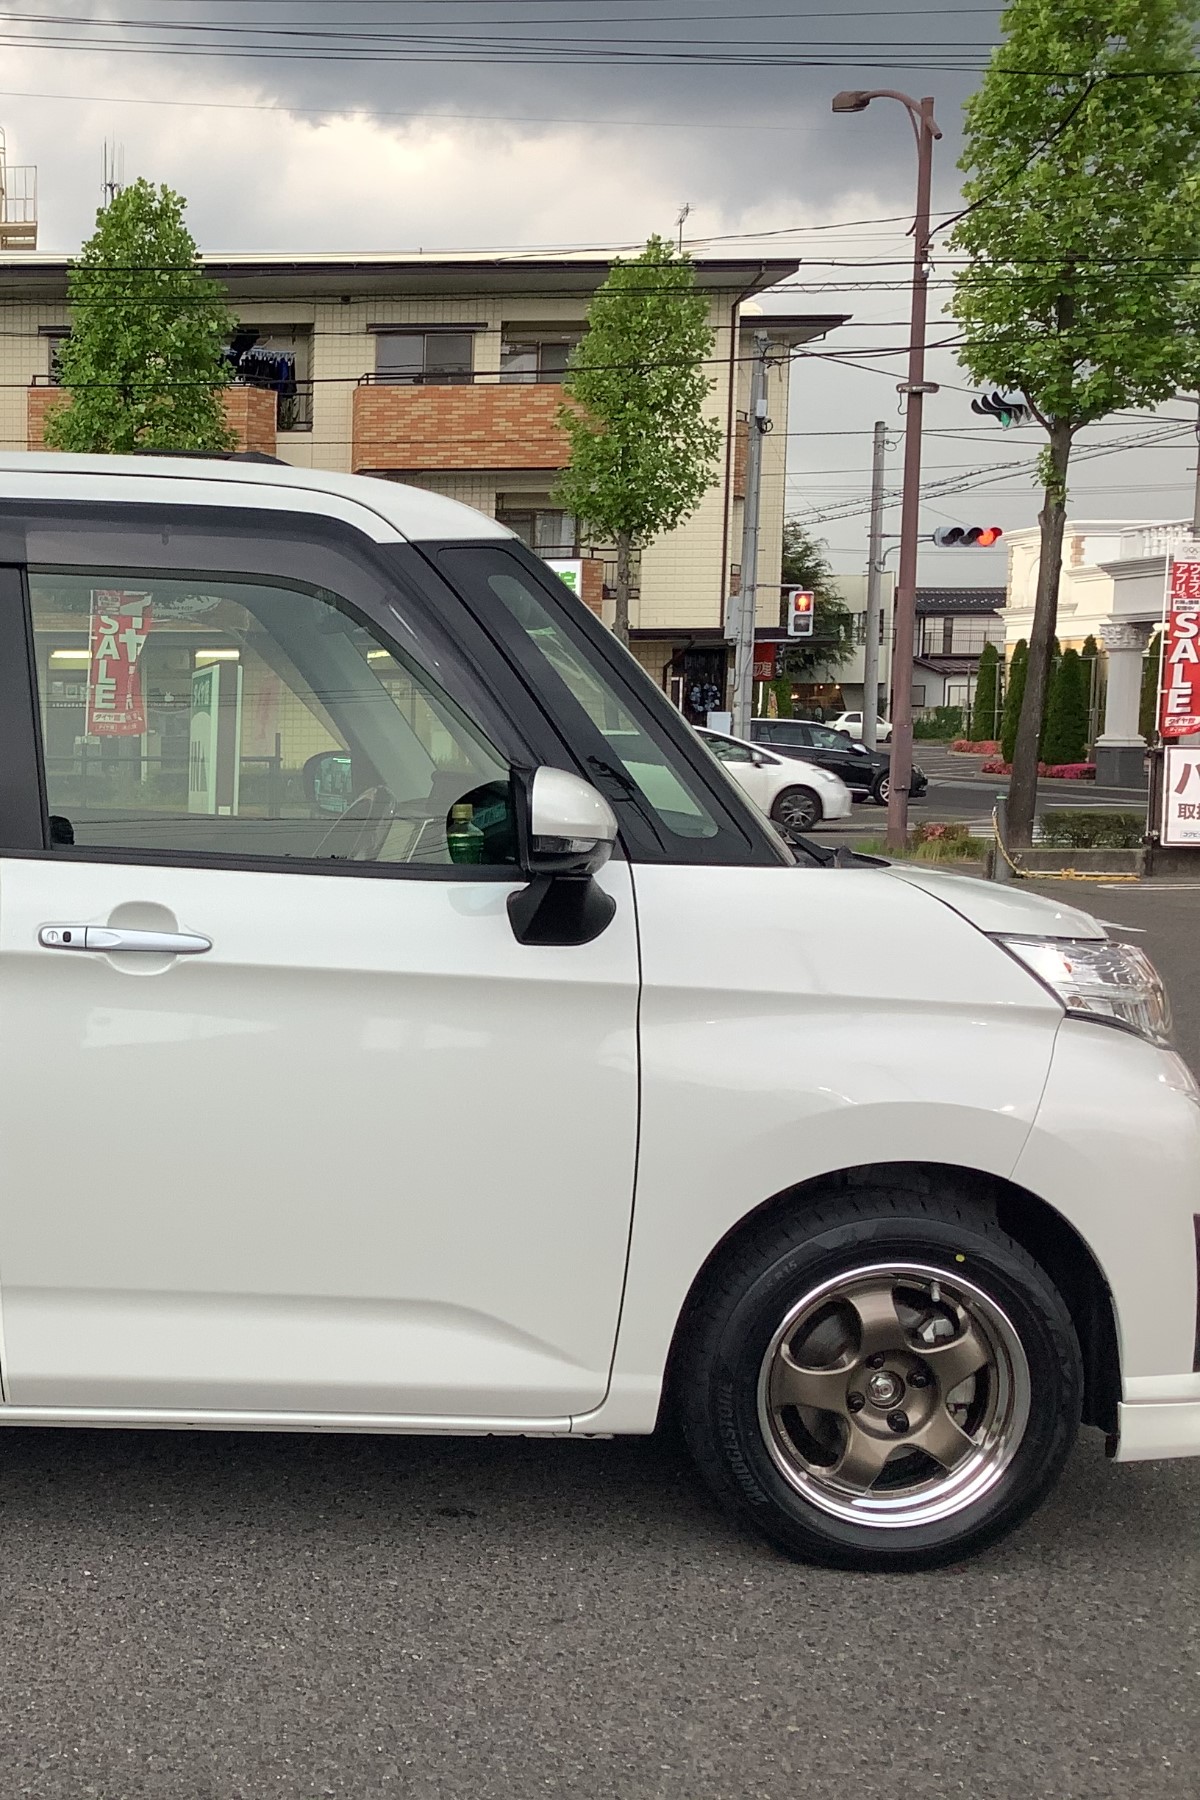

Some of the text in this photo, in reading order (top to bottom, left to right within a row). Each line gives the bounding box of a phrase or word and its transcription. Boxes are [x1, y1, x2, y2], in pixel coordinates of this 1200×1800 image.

[95, 615, 120, 709] SALE
[1167, 612, 1199, 713] SALE
[1178, 803, 1200, 820] 取
